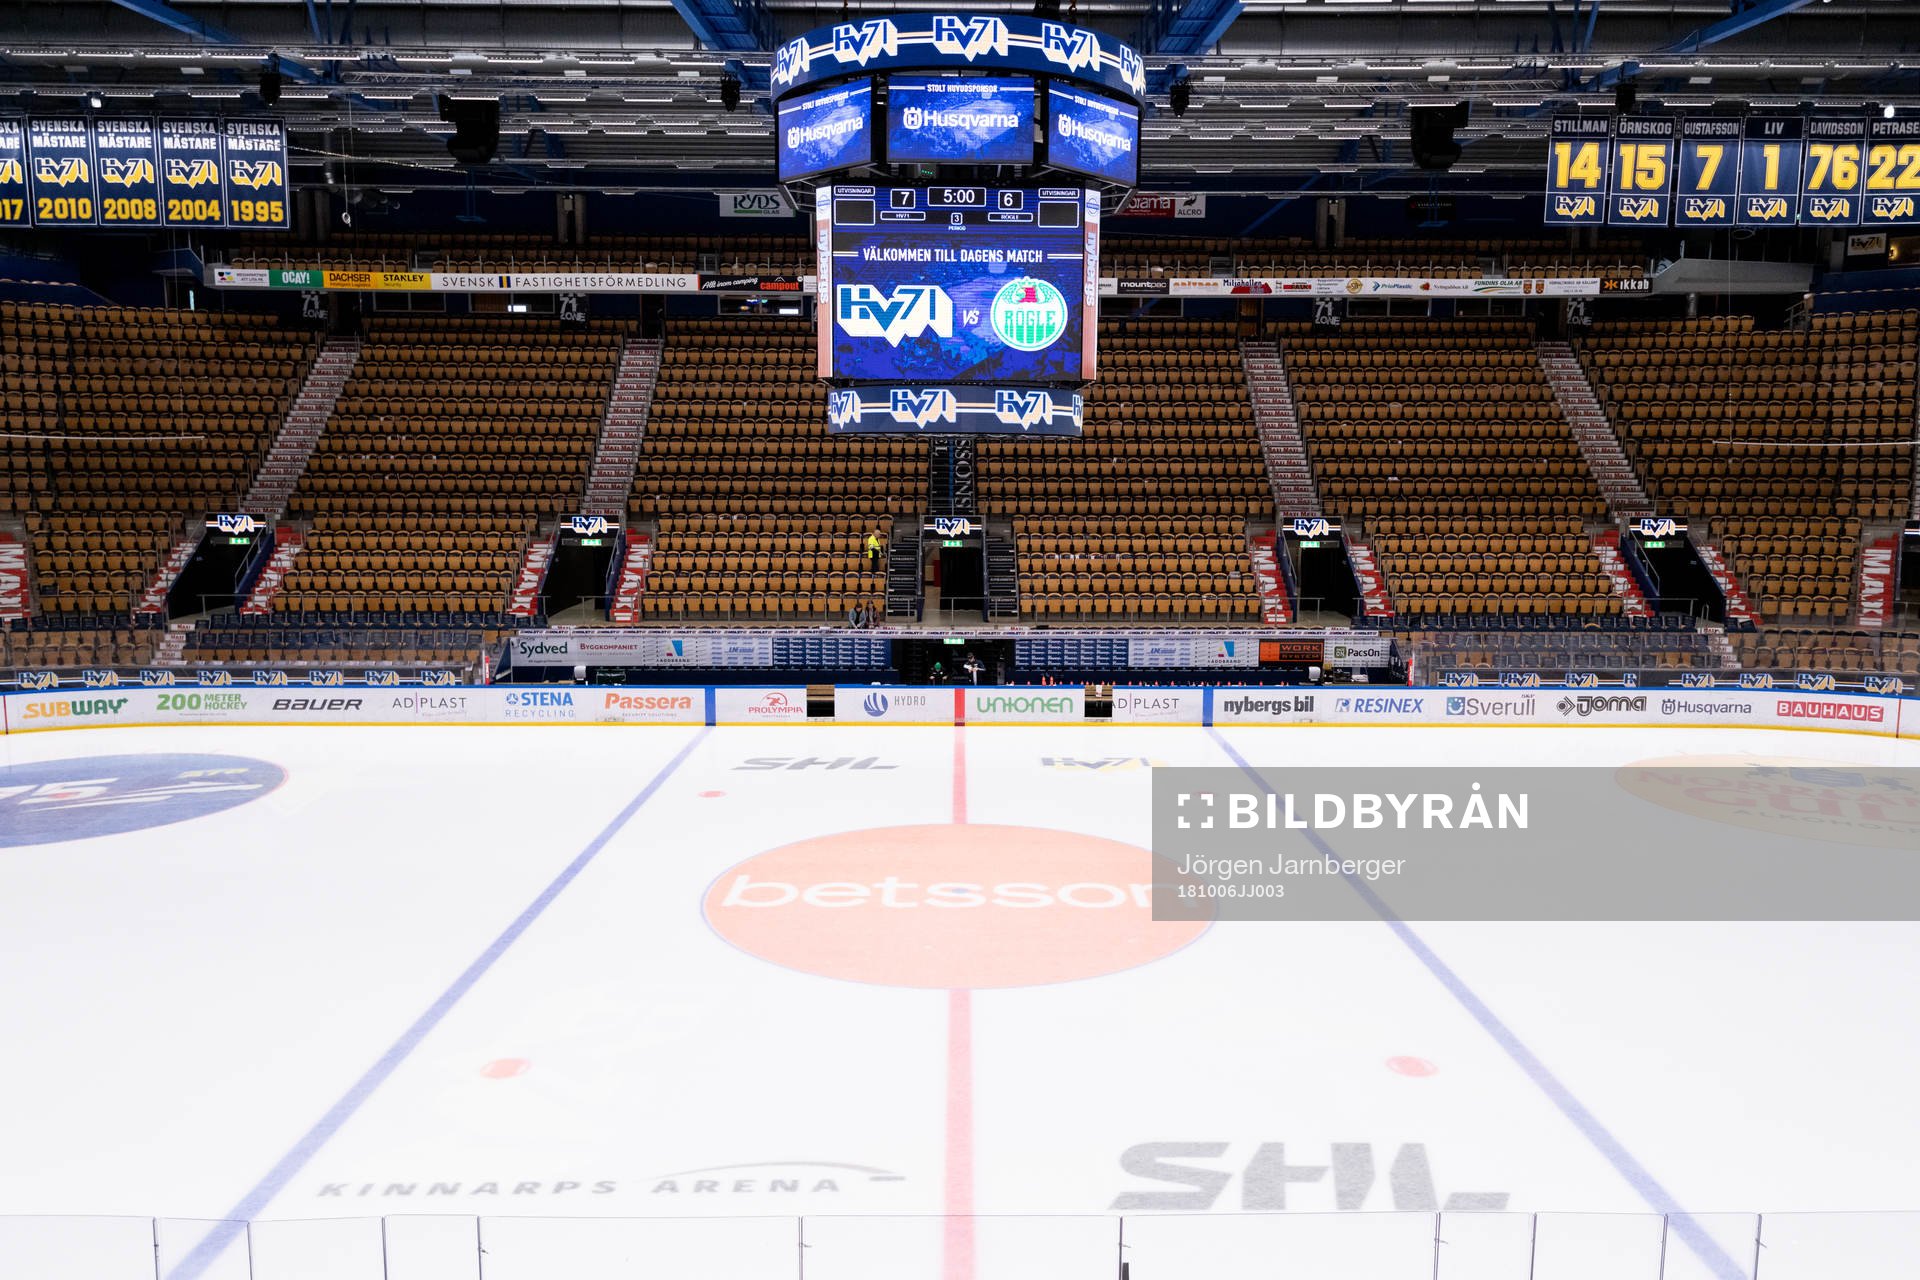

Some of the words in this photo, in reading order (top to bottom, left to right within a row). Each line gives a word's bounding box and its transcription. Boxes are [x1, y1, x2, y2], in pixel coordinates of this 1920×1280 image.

[833, 19, 898, 67] HV71
[933, 16, 1009, 61] HV71
[1042, 22, 1100, 72] HV71
[927, 84, 946, 93] STOLT
[32, 120, 86, 132] SVENSKA
[97, 121, 151, 133] SVENSKA
[162, 122, 216, 134] SVENSKA
[800, 114, 864, 141] Husqvarna
[923, 108, 1020, 132] Husqvarna
[1554, 119, 1608, 134] STILLMAN
[1619, 118, 1672, 135] ÖRNSKOG
[1764, 122, 1784, 135] LIV
[1810, 122, 1864, 135] DAVIDSSON
[226, 123, 280, 136] SVENSKA
[1072, 120, 1132, 152] Husqvarna
[1684, 122, 1740, 136] GUSTAFSSON
[32, 134, 86, 148] MÄSTARE
[98, 134, 152, 149] MÄSTARE
[164, 134, 217, 150] MÄSTARE
[228, 137, 280, 152] MÄSTARE
[34, 158, 90, 188] HV71
[100, 158, 154, 188] HV71
[165, 159, 219, 189] HV71
[1554, 142, 1602, 189] 14
[1620, 143, 1666, 190] 15
[1696, 144, 1724, 190] 7
[1763, 144, 1780, 190] 1
[1808, 144, 1860, 190] 76
[1867, 144, 1920, 190] 22
[229, 159, 282, 190] HV71
[734, 194, 780, 210] RYDS
[900, 192, 910, 205] 7
[943, 190, 975, 203] 5:00
[1004, 193, 1013, 206] 6
[38, 198, 92, 220] 2010
[104, 199, 157, 220] 2008
[168, 199, 221, 221] 2004
[231, 200, 284, 222] 1995
[1555, 195, 1596, 220] HV71
[1685, 198, 1726, 220] HV71
[1746, 196, 1788, 220] HV71
[1872, 196, 1914, 220] HV71
[954, 214, 960, 223] 3
[863, 246, 932, 262] VÄLKOMMEN
[934, 249, 958, 262] TILL
[960, 250, 1004, 263] DAGENS
[1006, 250, 1044, 264] MATCH
[282, 272, 310, 284] OCAY!
[329, 273, 371, 282] DACHSER
[384, 274, 424, 282] STANLEY
[442, 277, 494, 287] SVENSK
[515, 274, 687, 288] FASTIGHETSFÖRMEDLING
[760, 280, 800, 292] campout
[837, 284, 953, 348] HV71
[962, 308, 980, 327] VS
[890, 389, 956, 430] HV71
[995, 390, 1053, 431] HV71
[217, 514, 255, 535] HV71
[572, 516, 607, 536] HV71
[935, 518, 970, 538] HV71
[1294, 518, 1329, 538] HV71
[1640, 518, 1676, 538] HV71
[1859, 549, 1892, 626] MAXI
[520, 642, 568, 658] Sydved
[1348, 648, 1380, 657] PacsOn
[19, 672, 58, 690] HV71
[83, 670, 118, 687] HV71
[198, 670, 232, 686] HV71
[252, 670, 288, 686] HV71
[364, 670, 400, 686] HV71
[1446, 672, 1478, 687] HV71
[1507, 672, 1540, 687] HV71
[1682, 673, 1714, 688] HV71
[1798, 673, 1835, 690] HV71
[1864, 676, 1902, 694] HV71
[156, 694, 200, 710] 200
[204, 694, 242, 702] METER
[204, 701, 248, 710] HOCKEY
[521, 692, 574, 706] STENA
[605, 693, 692, 710] Passera
[894, 696, 926, 706] HYDRO
[977, 697, 1074, 713] UNIONEN
[1224, 696, 1291, 715] nybergs
[1294, 696, 1314, 712] bil
[1354, 698, 1424, 713] RESINEX
[22, 698, 128, 719] SUBWAY
[1466, 698, 1535, 716] Sverull
[1678, 701, 1752, 714] Husqvarna
[1779, 702, 1881, 720] BAUHAUS
[730, 757, 900, 771] SHL
[722, 874, 1198, 909] betsson
[1107, 1141, 1511, 1212] SHL
[317, 1180, 620, 1198] KINNARPS
[652, 1179, 843, 1195] ARENA
